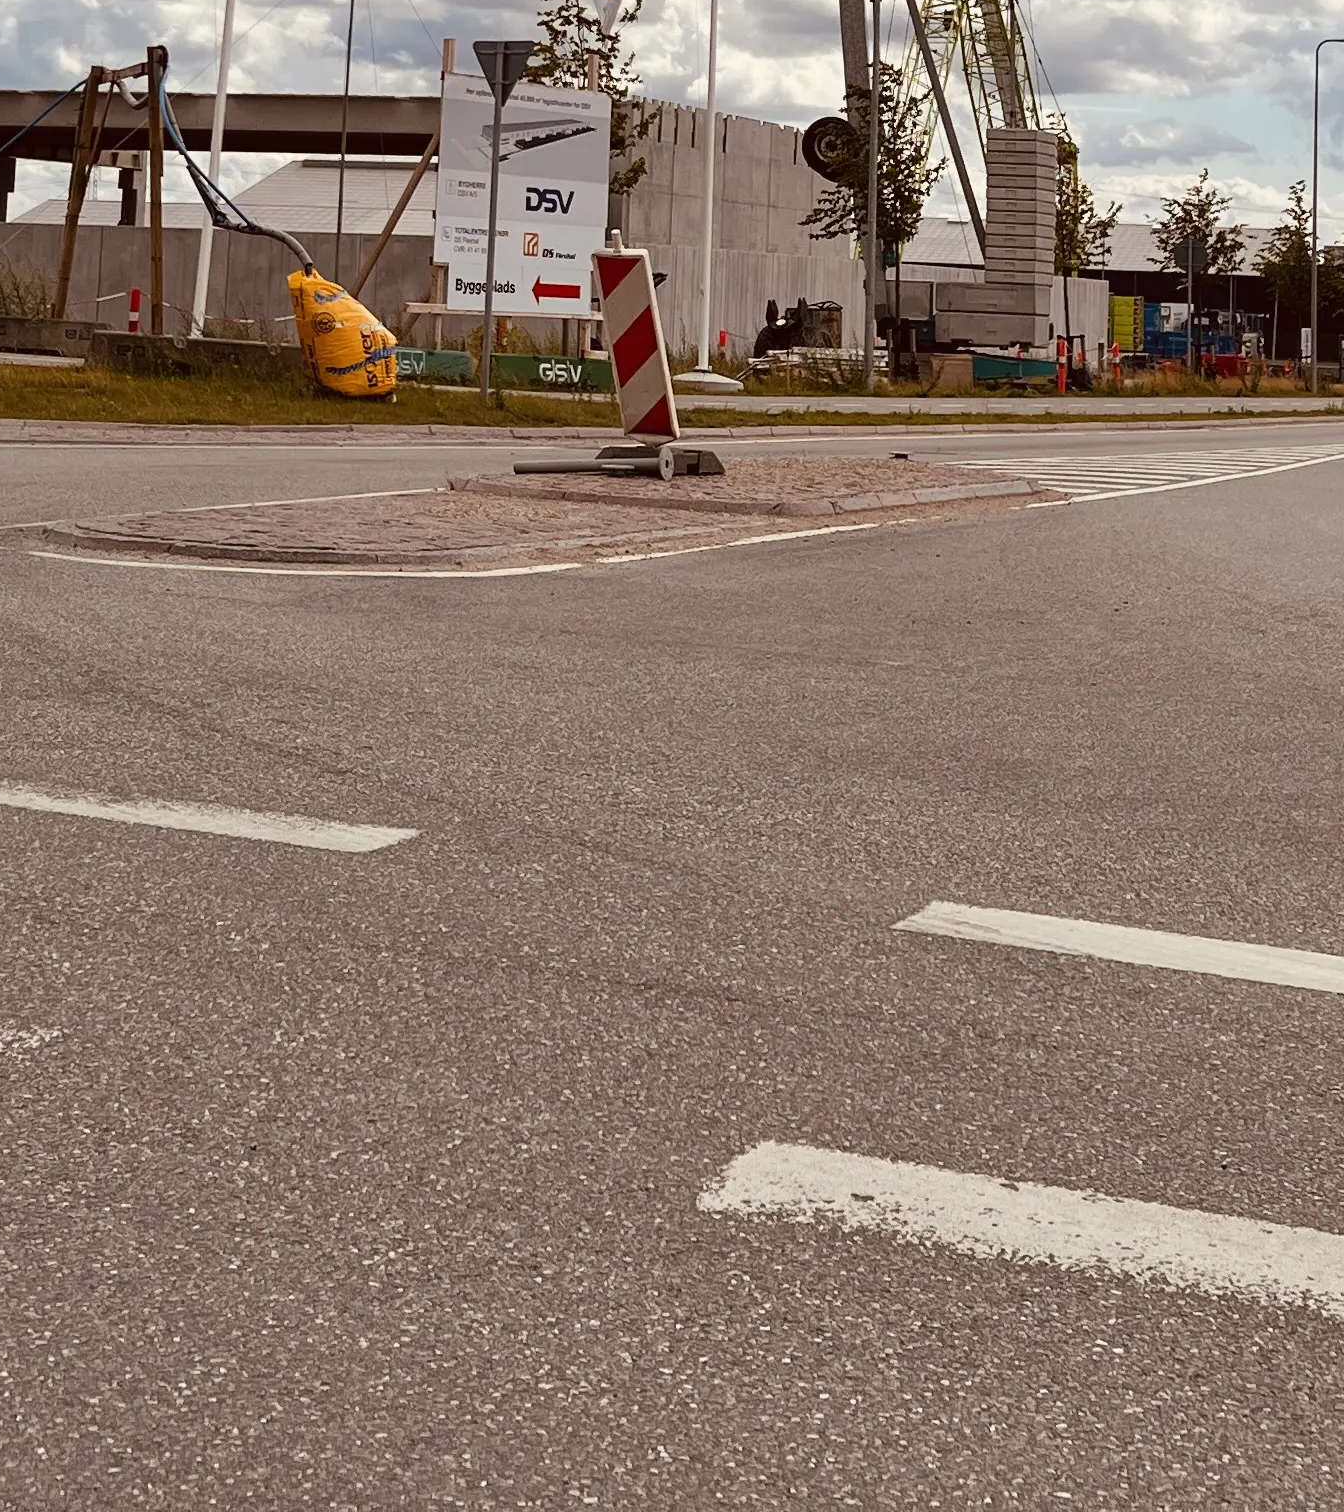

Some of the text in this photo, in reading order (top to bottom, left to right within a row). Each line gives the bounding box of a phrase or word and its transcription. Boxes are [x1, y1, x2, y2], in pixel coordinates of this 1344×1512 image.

[525, 186, 575, 215] DSV
[542, 248, 555, 259] DS
[455, 278, 516, 295] Byggelads
[396, 359, 424, 376] SV
[539, 360, 582, 384] GSV
